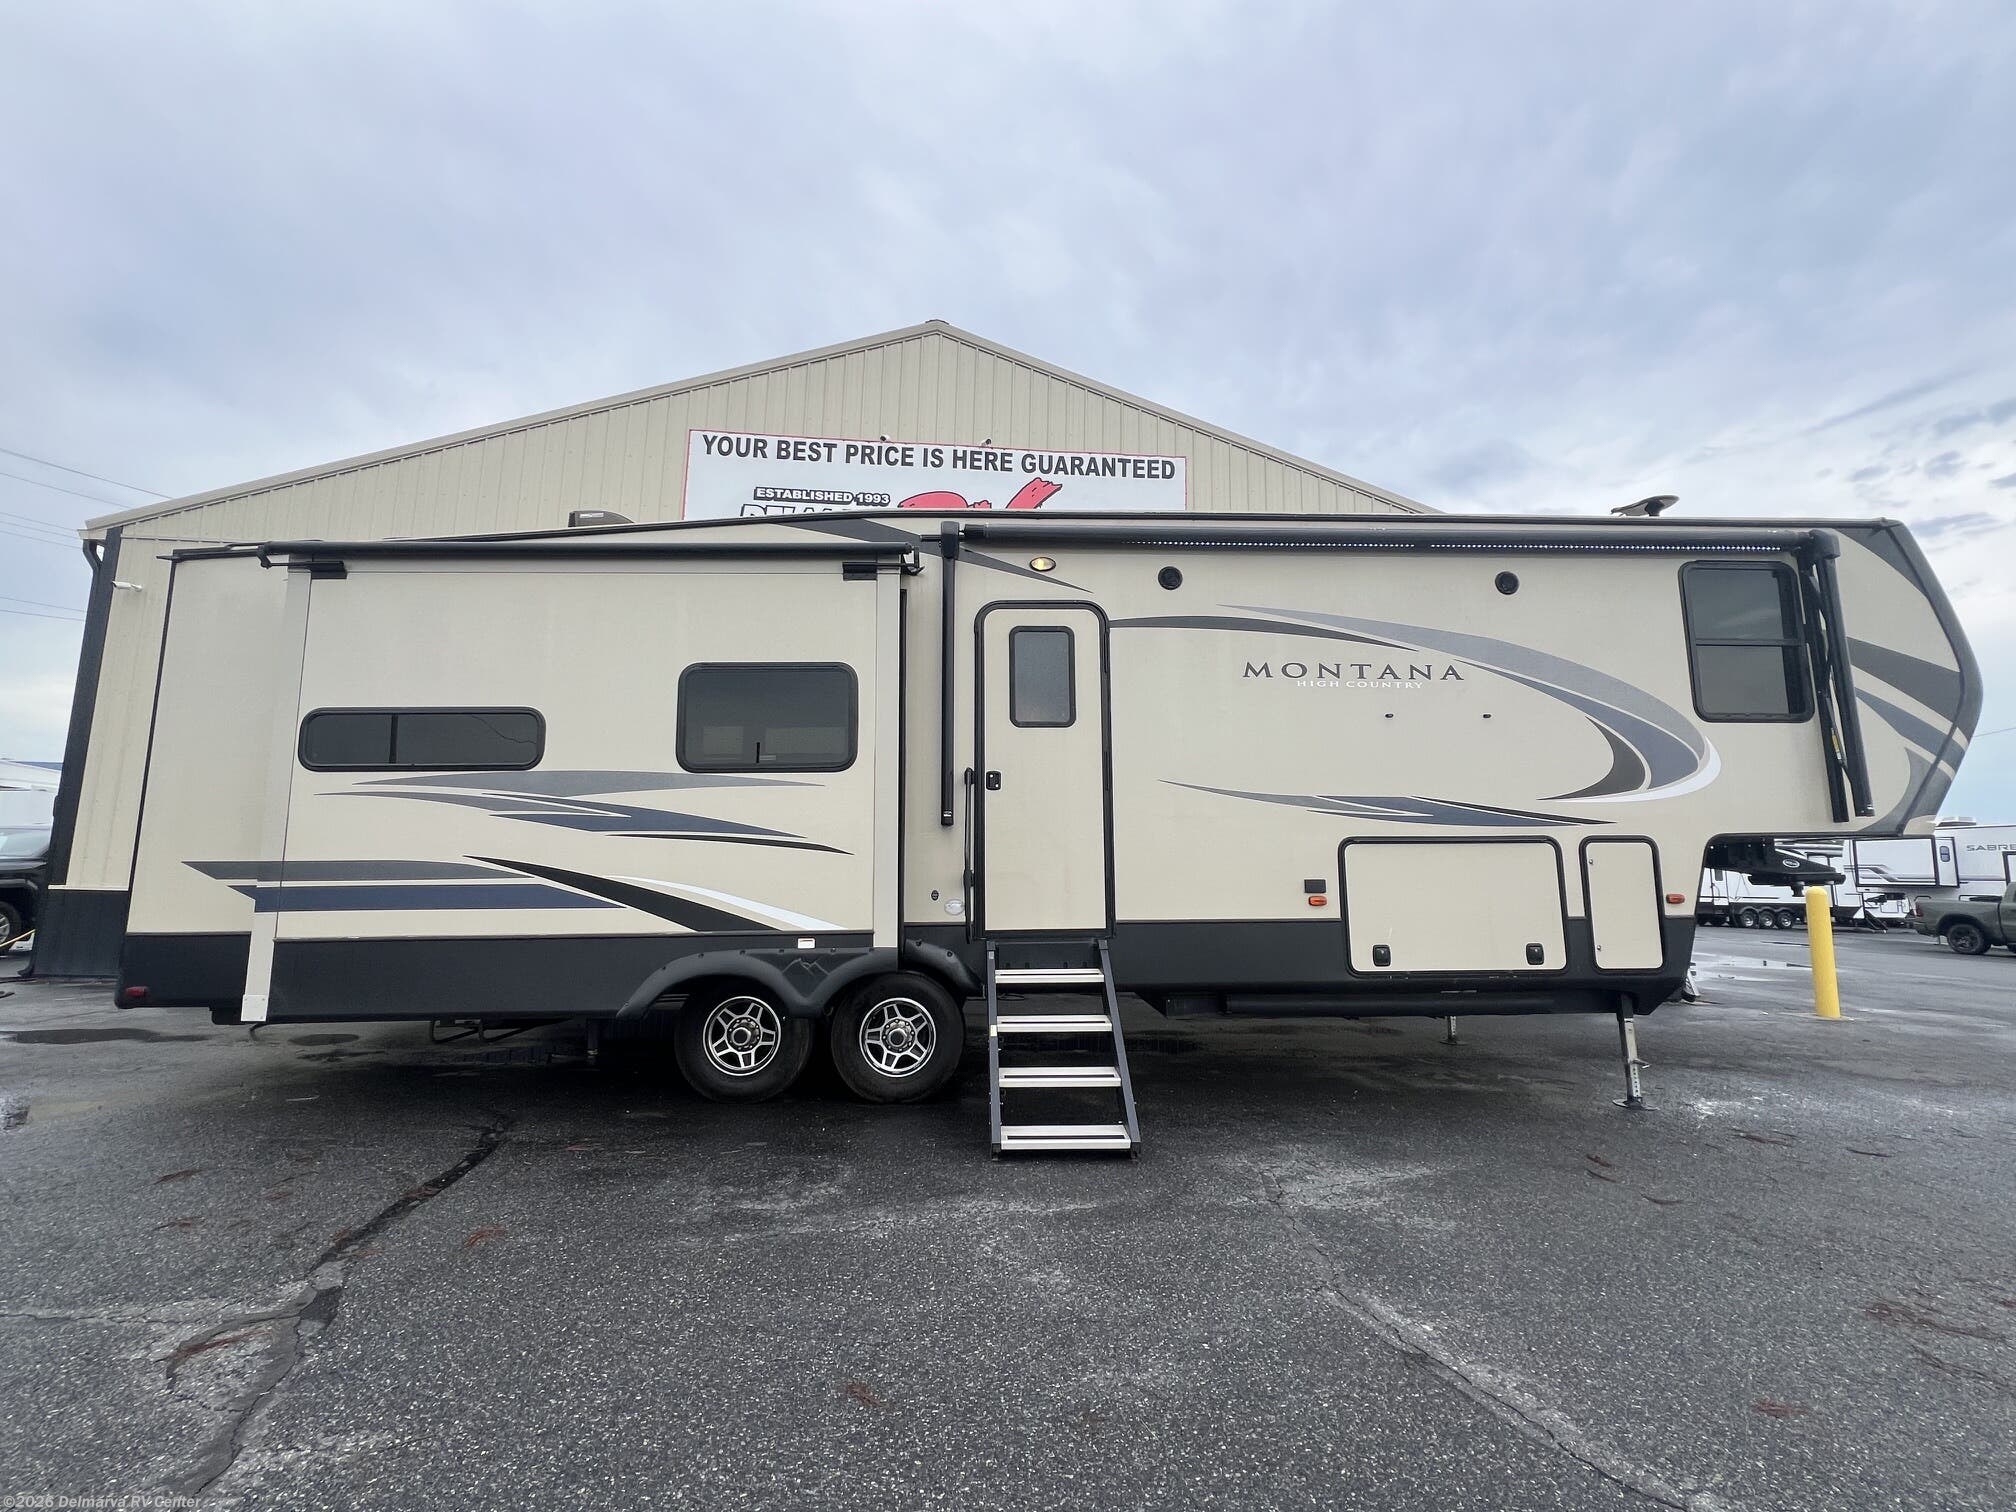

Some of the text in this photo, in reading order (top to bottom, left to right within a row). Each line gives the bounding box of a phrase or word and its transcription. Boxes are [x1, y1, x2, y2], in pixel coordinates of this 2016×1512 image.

[702, 434, 1176, 480] YOUR BEST PRICE IS HERE GUARANTEED
[755, 488, 890, 505] ESTABLISHED 1993
[1242, 661, 1465, 680] MONTANA
[1296, 680, 1424, 689] HIGH COUNTRY
